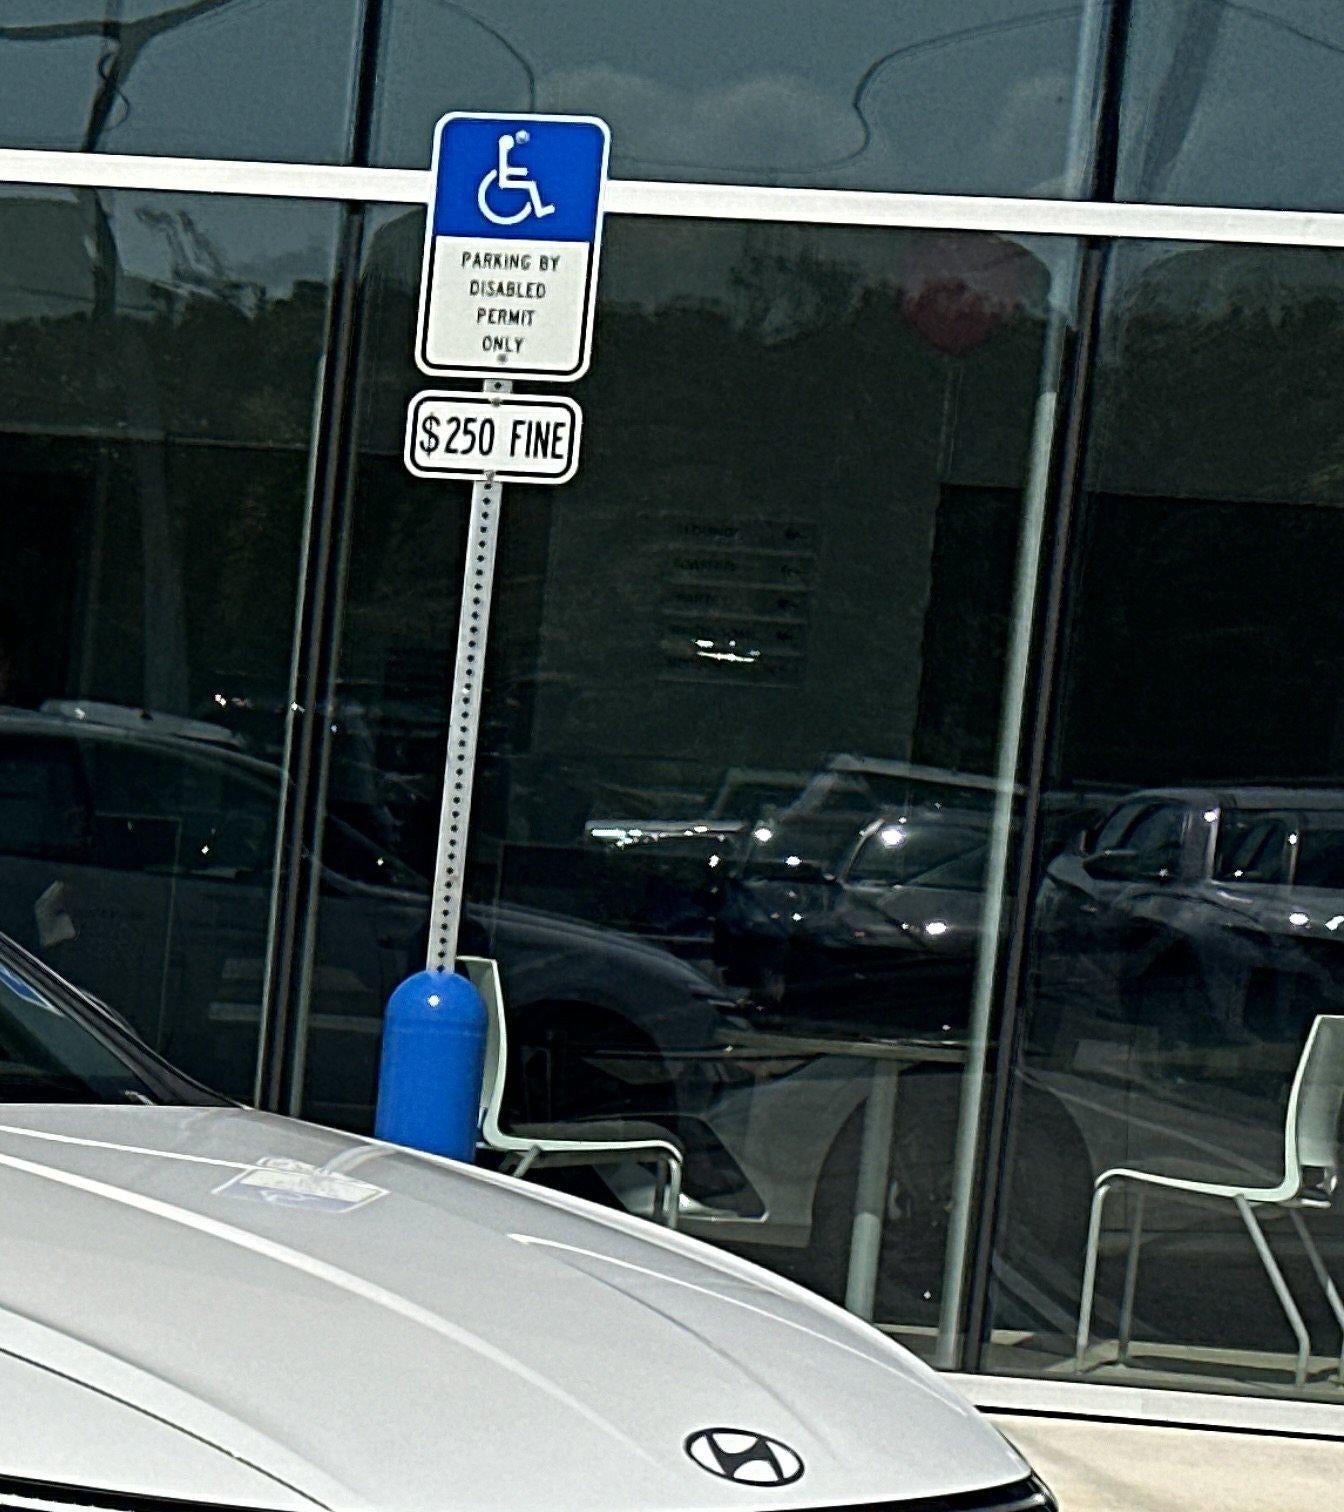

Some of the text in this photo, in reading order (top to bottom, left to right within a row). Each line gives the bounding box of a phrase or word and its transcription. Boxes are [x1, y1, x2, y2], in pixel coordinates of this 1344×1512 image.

[461, 251, 561, 272] PARKING BY
[469, 279, 547, 299] DISABLED
[476, 307, 536, 327] PERMIT
[482, 335, 525, 354] ONLY
[419, 411, 566, 460] $250 FINE
